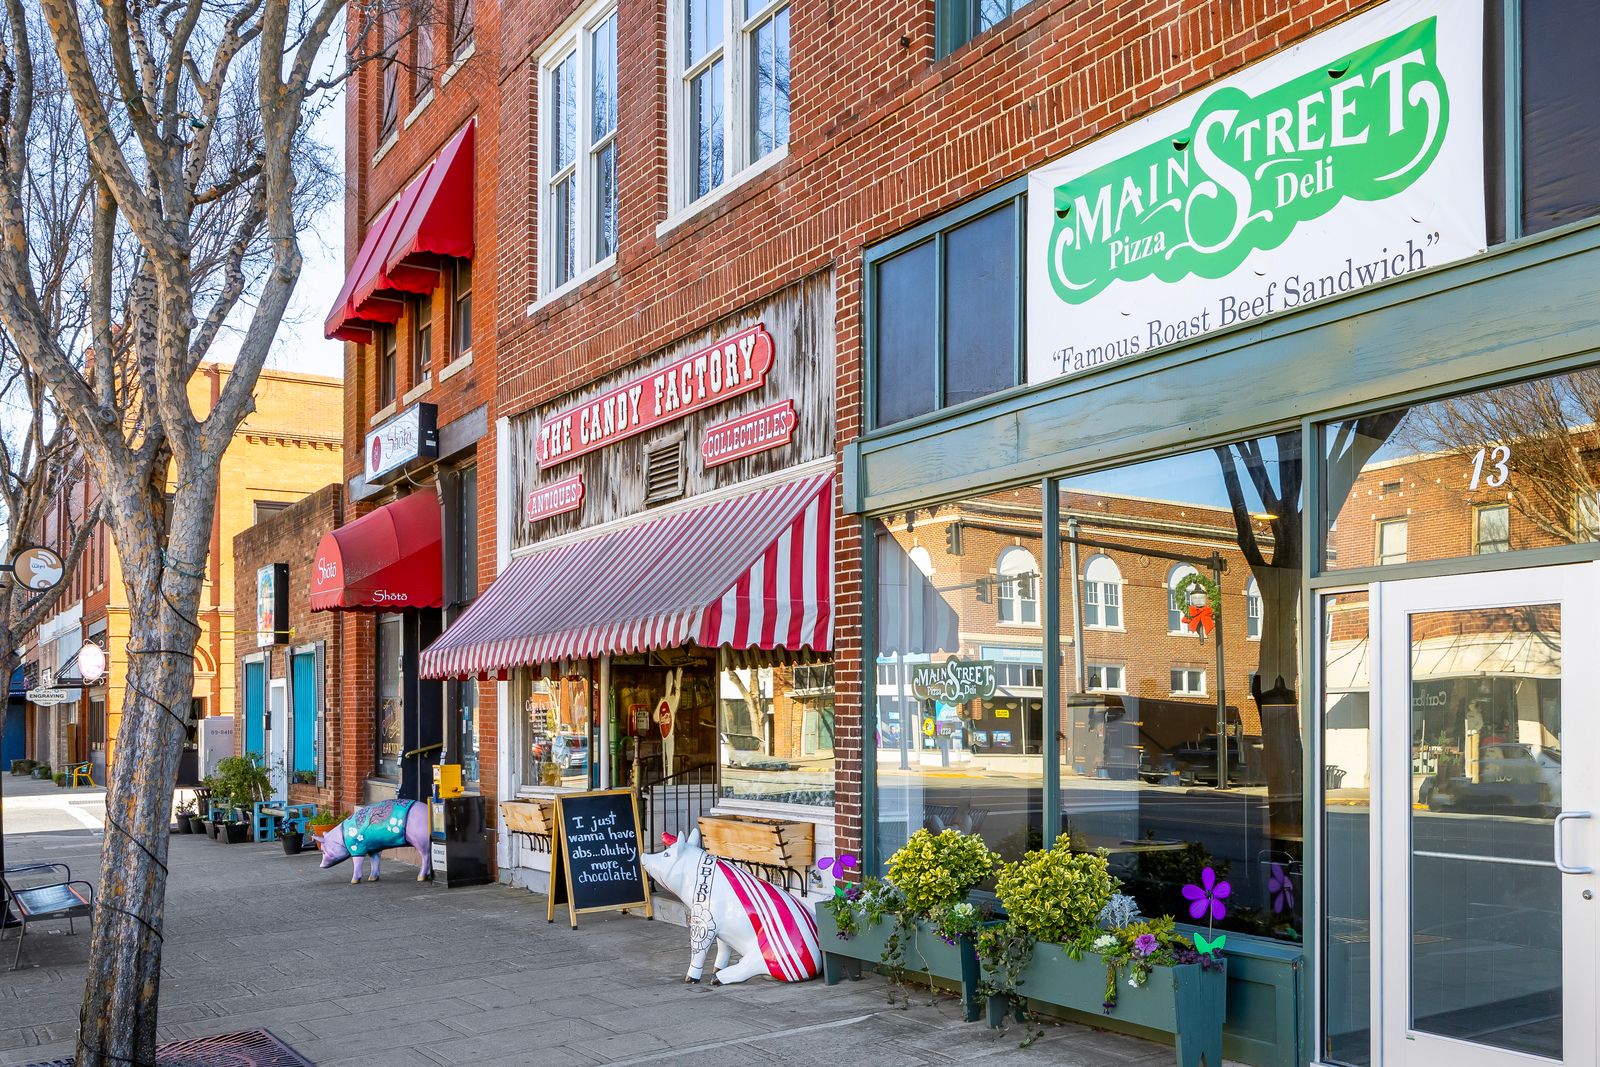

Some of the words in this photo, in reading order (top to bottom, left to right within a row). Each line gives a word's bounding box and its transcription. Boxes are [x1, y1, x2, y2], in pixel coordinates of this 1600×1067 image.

[1060, 149, 1190, 275] MAIN
[1178, 48, 1440, 256] STREET
[1275, 155, 1335, 209] Deli
[1108, 230, 1166, 271] Pizza
[1053, 334, 1141, 375] “Famous
[1146, 306, 1211, 351] Roast
[1217, 281, 1277, 329] Beef
[1283, 231, 1440, 309] Sandwich”
[541, 418, 572, 460] THE
[580, 385, 643, 445] CANDY
[653, 333, 756, 417] FACTORY
[707, 411, 787, 458] COLLECTIBLES
[1469, 446, 1511, 490] 13
[530, 484, 577, 516] ANTIQUES
[914, 668, 947, 690] MAIN
[943, 660, 996, 700] STREET
[568, 832, 605, 843] wanna
[608, 827, 635, 840] have
[572, 816, 584, 829] I
[590, 810, 617, 833] just
[578, 865, 638, 884] chocolate!
[591, 860, 619, 870] more
